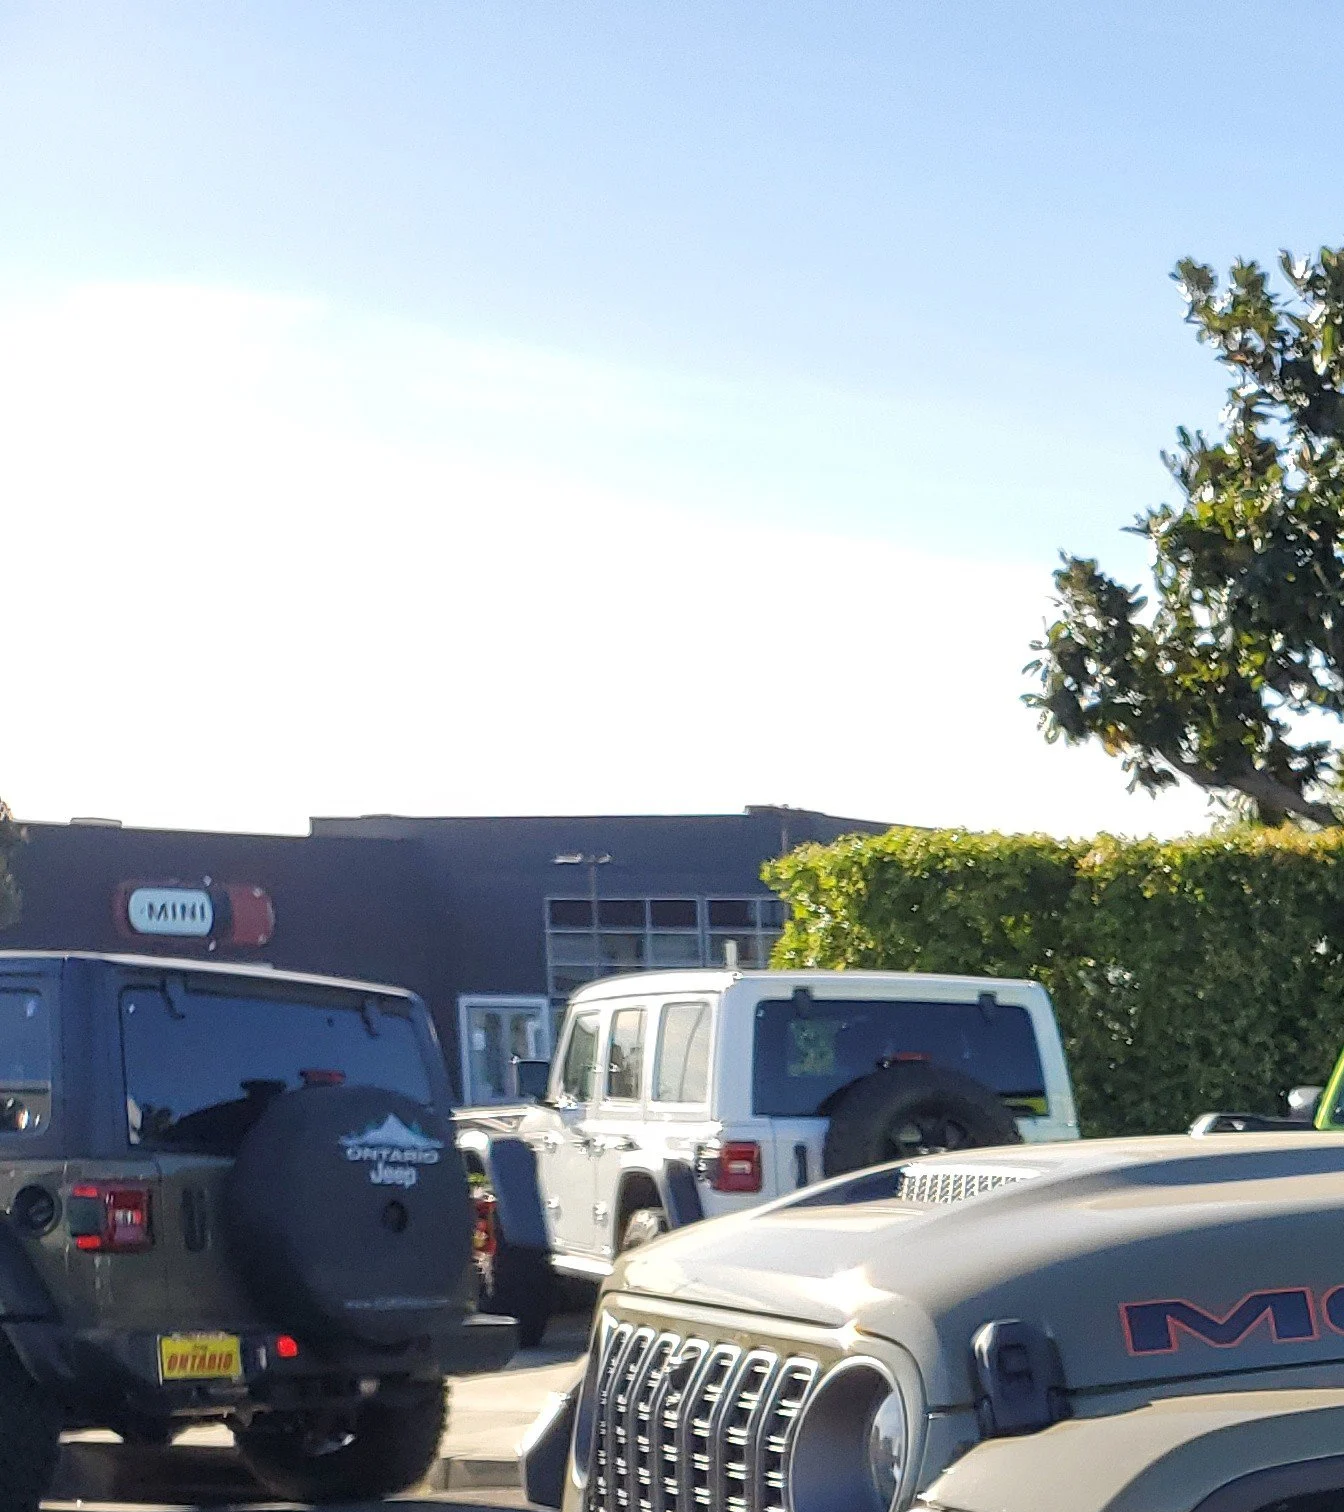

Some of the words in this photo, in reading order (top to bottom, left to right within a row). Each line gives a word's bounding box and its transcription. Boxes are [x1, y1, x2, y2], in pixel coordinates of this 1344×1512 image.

[146, 901, 206, 921] MINI
[346, 1146, 440, 1164] ONTARIO
[369, 1160, 417, 1189] Jeep
[167, 1353, 233, 1371] ONTARIO
